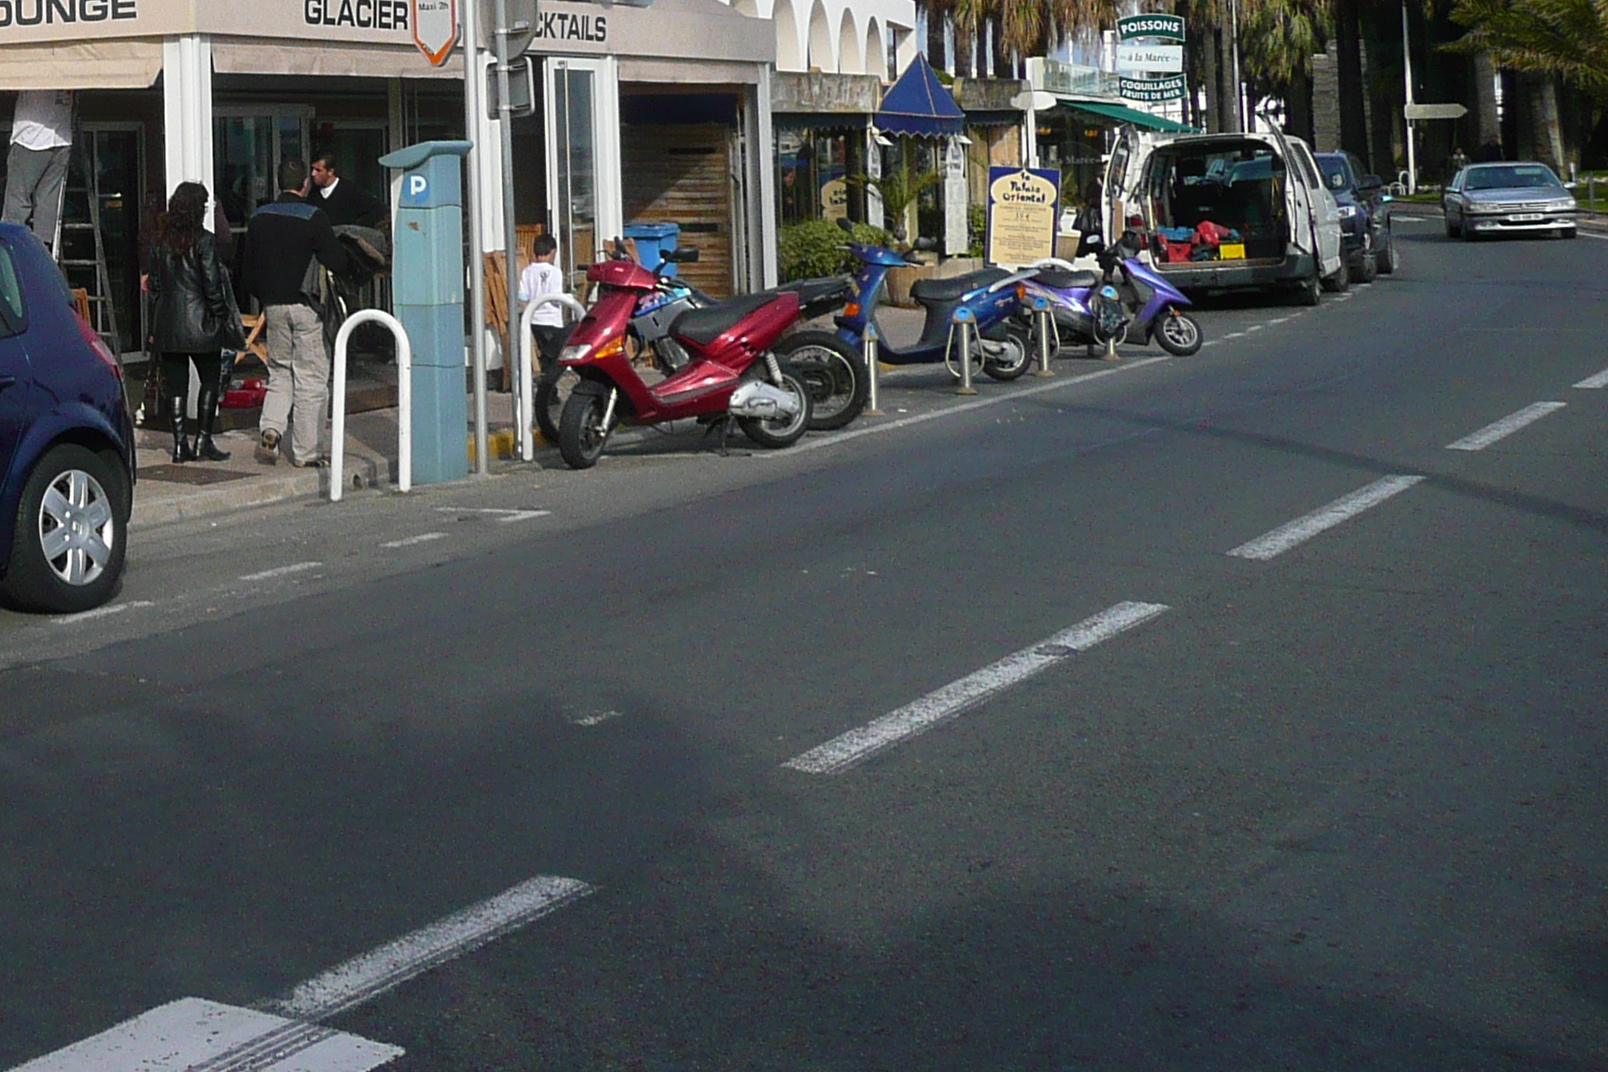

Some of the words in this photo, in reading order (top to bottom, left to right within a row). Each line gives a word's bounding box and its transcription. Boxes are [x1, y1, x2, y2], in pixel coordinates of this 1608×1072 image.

[535, 12, 606, 42] KTAILS
[1120, 20, 1181, 34] POISSONS
[1120, 79, 1182, 90] COQUILLAGES
[1122, 89, 1149, 99] FRUITS
[1163, 88, 1182, 98] MER
[410, 175, 427, 195] P
[1002, 193, 1046, 203] Oriental
